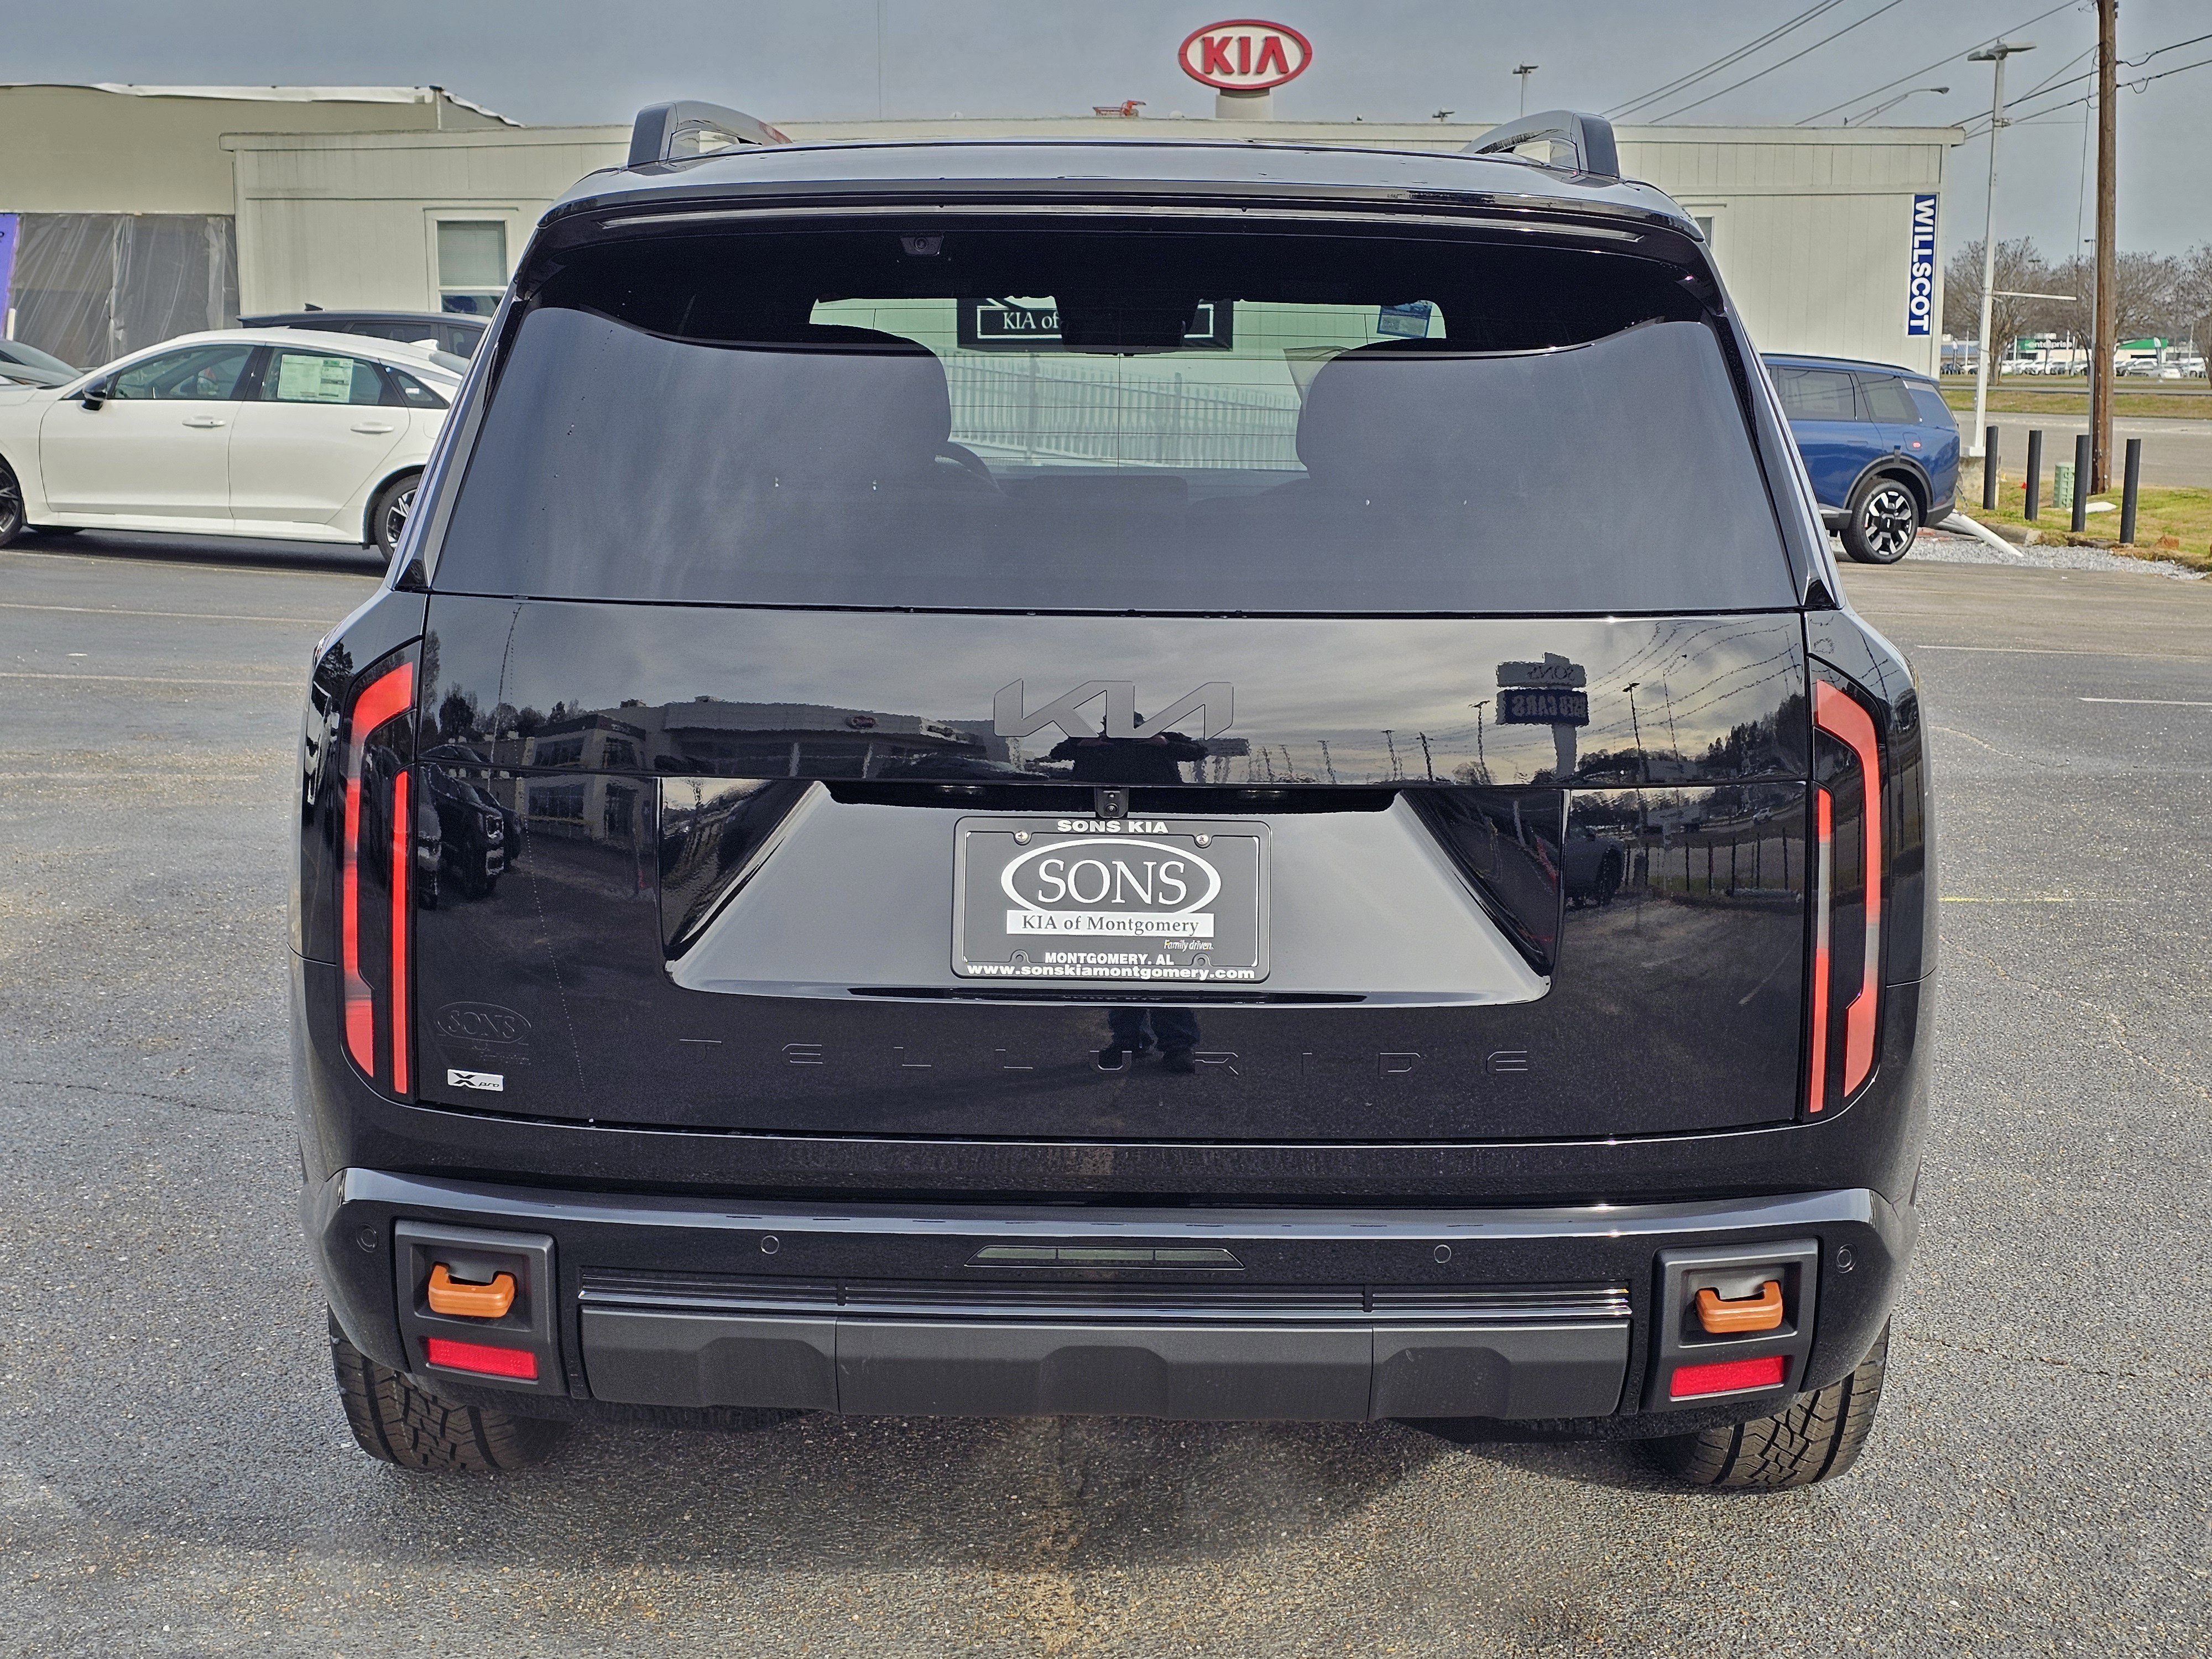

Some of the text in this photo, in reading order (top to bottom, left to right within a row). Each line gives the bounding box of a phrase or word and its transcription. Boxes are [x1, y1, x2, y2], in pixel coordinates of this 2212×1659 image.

[1201, 36, 1290, 74] KIA
[1910, 198, 1935, 331] WILLSCOT
[1003, 312, 1036, 329] KIA
[2027, 340, 2073, 349] enteprise
[994, 677, 1234, 740] KIA
[1057, 820, 1169, 833] SONS KIA
[1037, 859, 1187, 906] SONS
[1022, 915, 1199, 936] KIA of Montgomery
[1164, 940, 1189, 952] Family
[1155, 954, 1175, 966] AL
[967, 964, 1255, 980] www.sonskiamontgomery.com
[448, 1010, 515, 1038] SONS
[679, 1039, 1528, 1076] TELLURIDE
